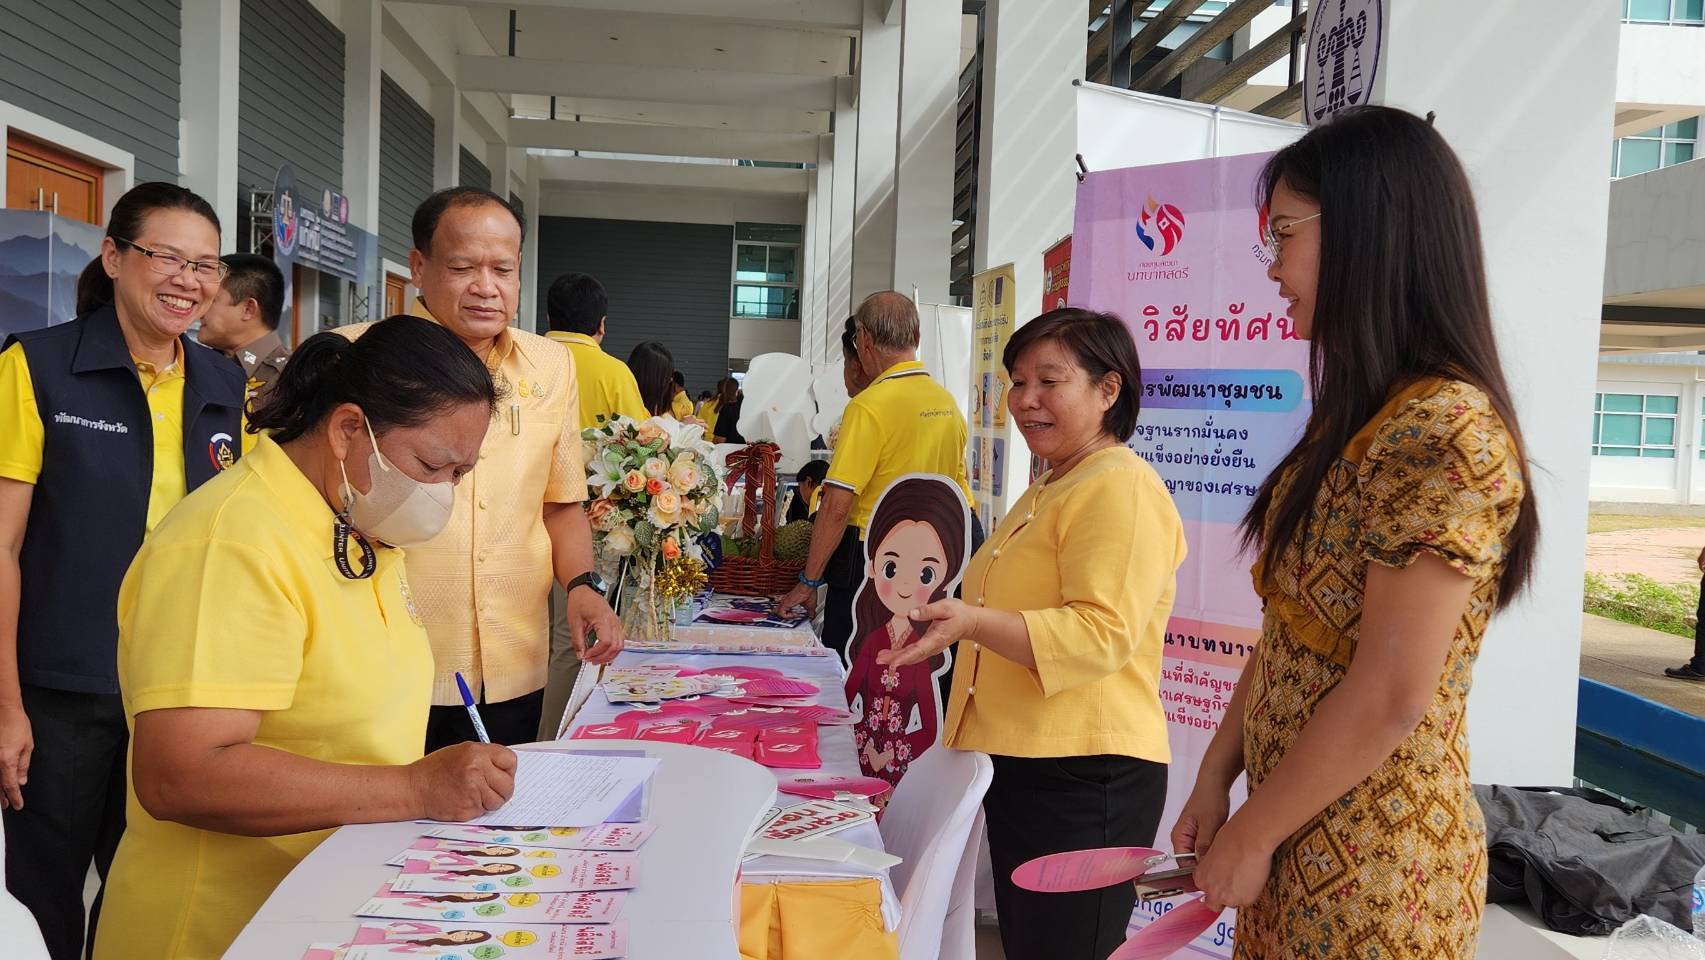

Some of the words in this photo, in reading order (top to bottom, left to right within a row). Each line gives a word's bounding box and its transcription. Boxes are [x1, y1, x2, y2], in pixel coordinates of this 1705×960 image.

[1127, 266, 1189, 281] บทบาทสตรี
[54, 412, 128, 434] พัฒนาการจังหวัด
